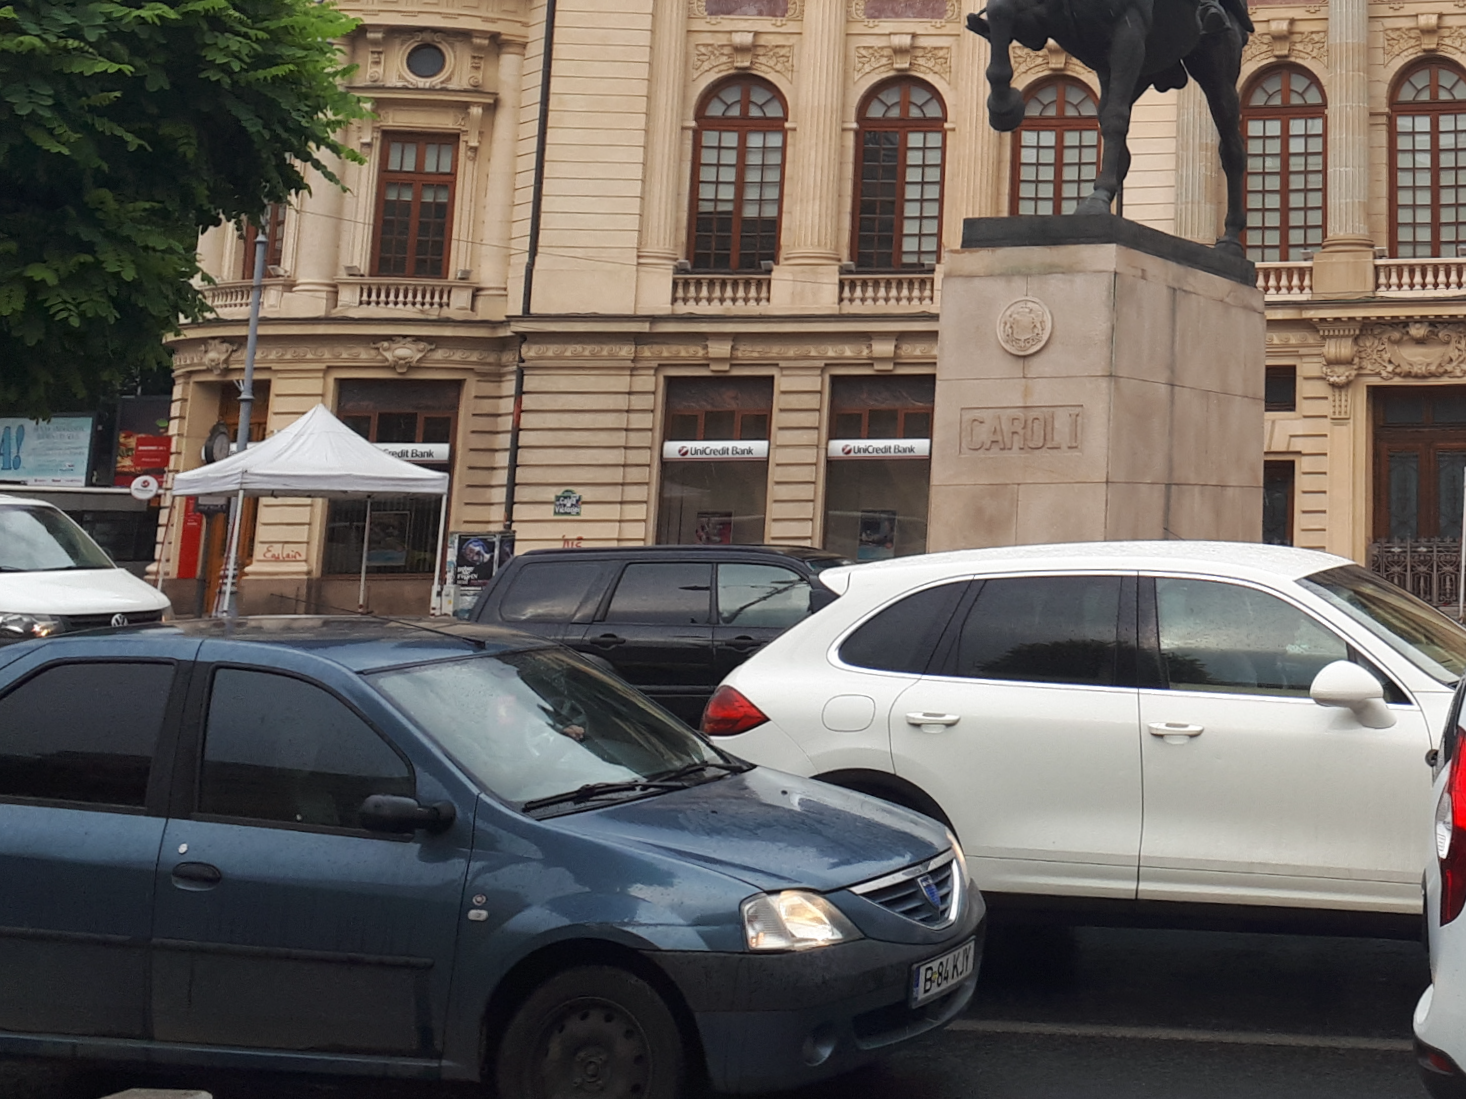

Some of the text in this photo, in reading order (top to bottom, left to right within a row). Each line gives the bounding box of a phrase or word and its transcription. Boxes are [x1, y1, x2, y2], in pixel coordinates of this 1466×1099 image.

[965, 410, 1080, 452] CAROL I
[411, 448, 435, 459] Bank
[689, 445, 754, 457] UniCredit Bank
[852, 443, 916, 455] UniCredit Bank
[936, 956, 950, 988] 84
